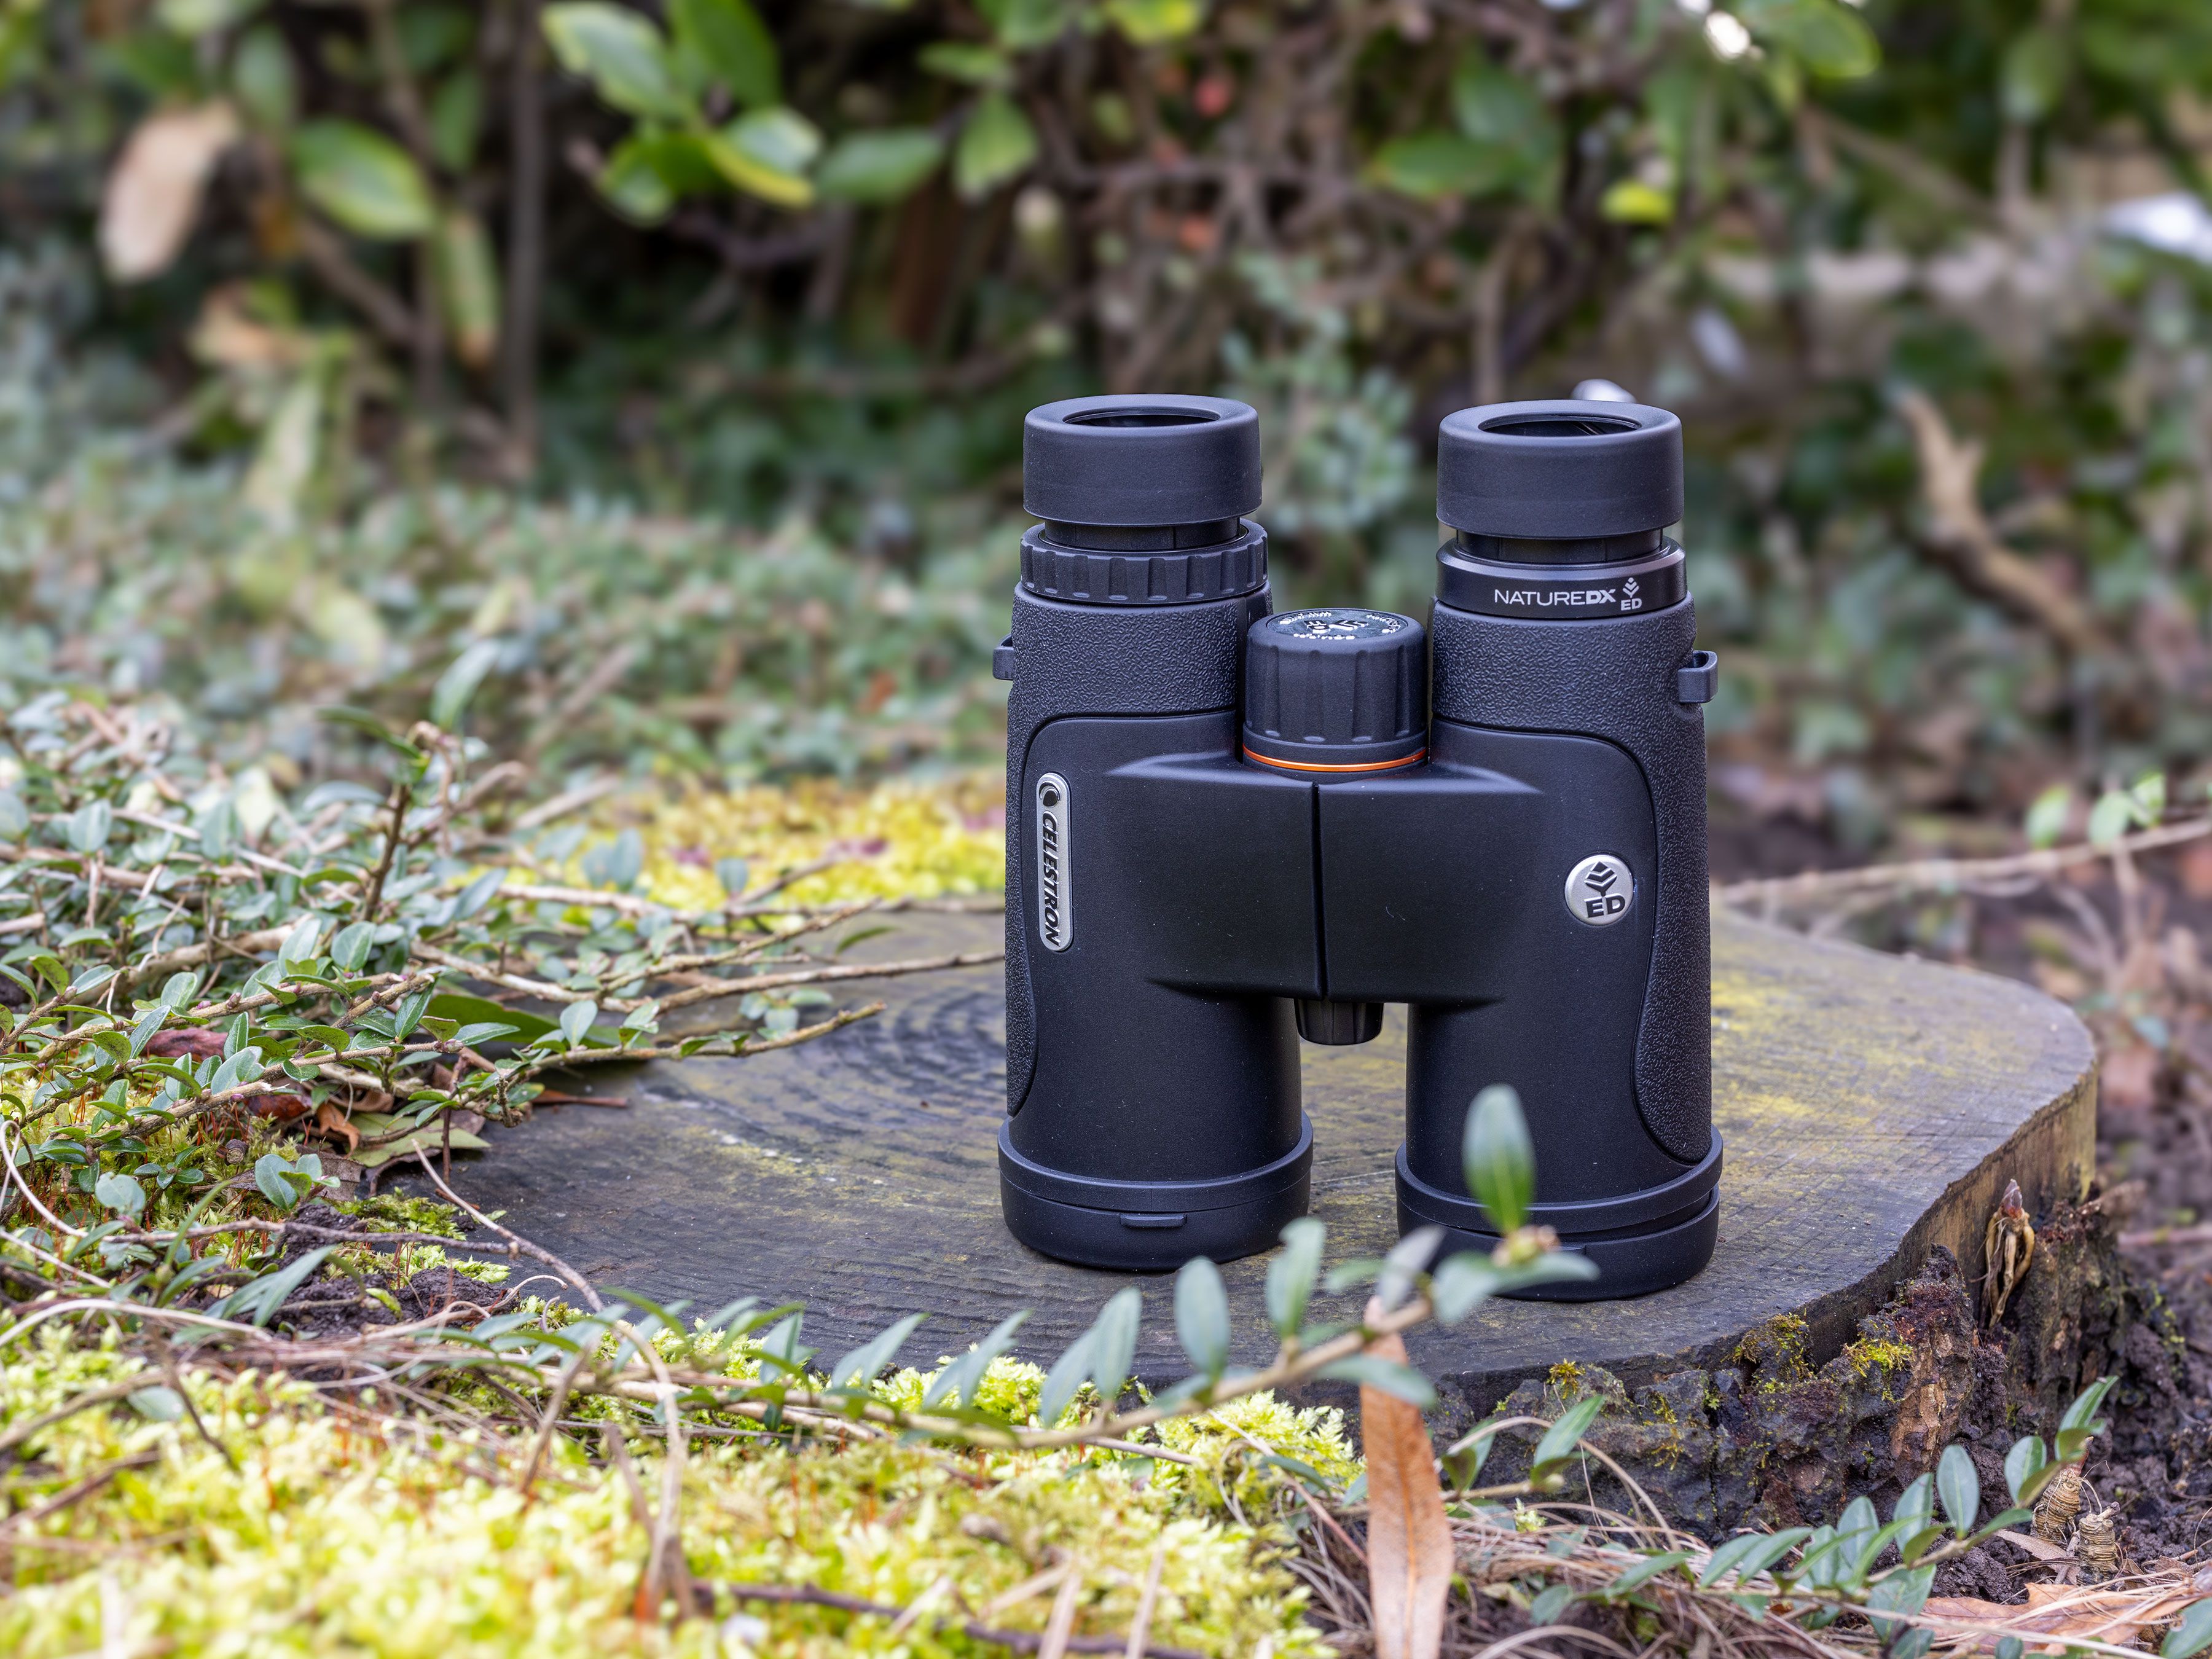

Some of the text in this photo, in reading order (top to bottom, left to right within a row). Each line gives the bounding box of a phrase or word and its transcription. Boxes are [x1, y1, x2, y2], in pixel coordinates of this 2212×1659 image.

[1494, 589, 1616, 606] NATUREDX
[1620, 598, 1642, 611] ED
[1043, 810, 1061, 947] CELESTRON
[1585, 894, 1626, 918] ED
